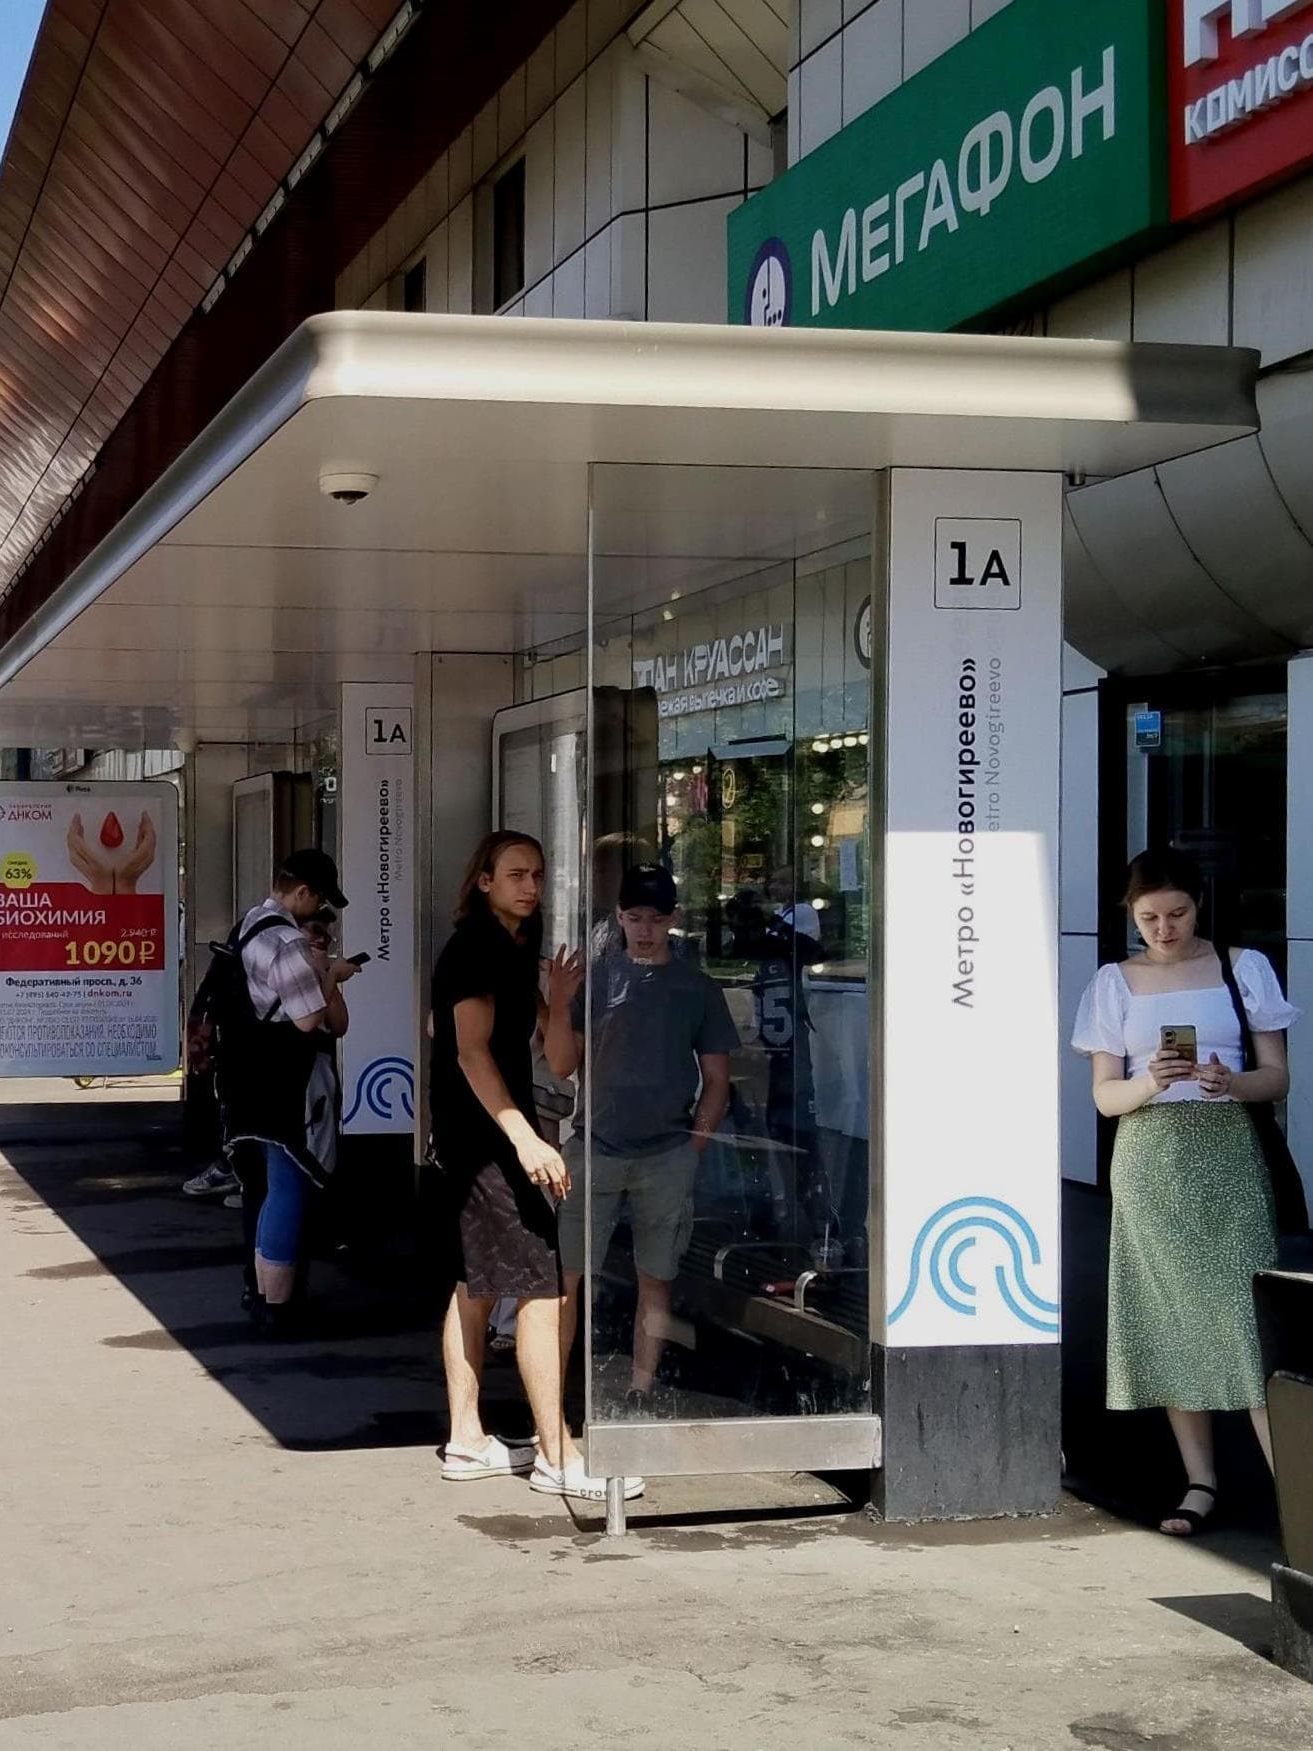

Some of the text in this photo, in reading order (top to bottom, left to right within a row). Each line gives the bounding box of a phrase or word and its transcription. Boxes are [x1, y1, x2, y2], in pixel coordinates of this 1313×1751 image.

[811, 45, 1115, 316] МЕГАФОН
[683, 623, 783, 687] КРУАССАН
[985, 657, 1004, 832] etro Novogireevo
[7, 810, 52, 821] ДНКОМ
[952, 658, 981, 1008] Метро «Новогиреево»
[5, 868, 33, 879] 63%
[377, 780, 393, 961] Метро «Новогиреево»
[2, 929, 70, 940] исследований
[5, 976, 81, 988] Федеративный
[130, 976, 143, 986] 36
[87, 989, 133, 998] dnkom.ru
